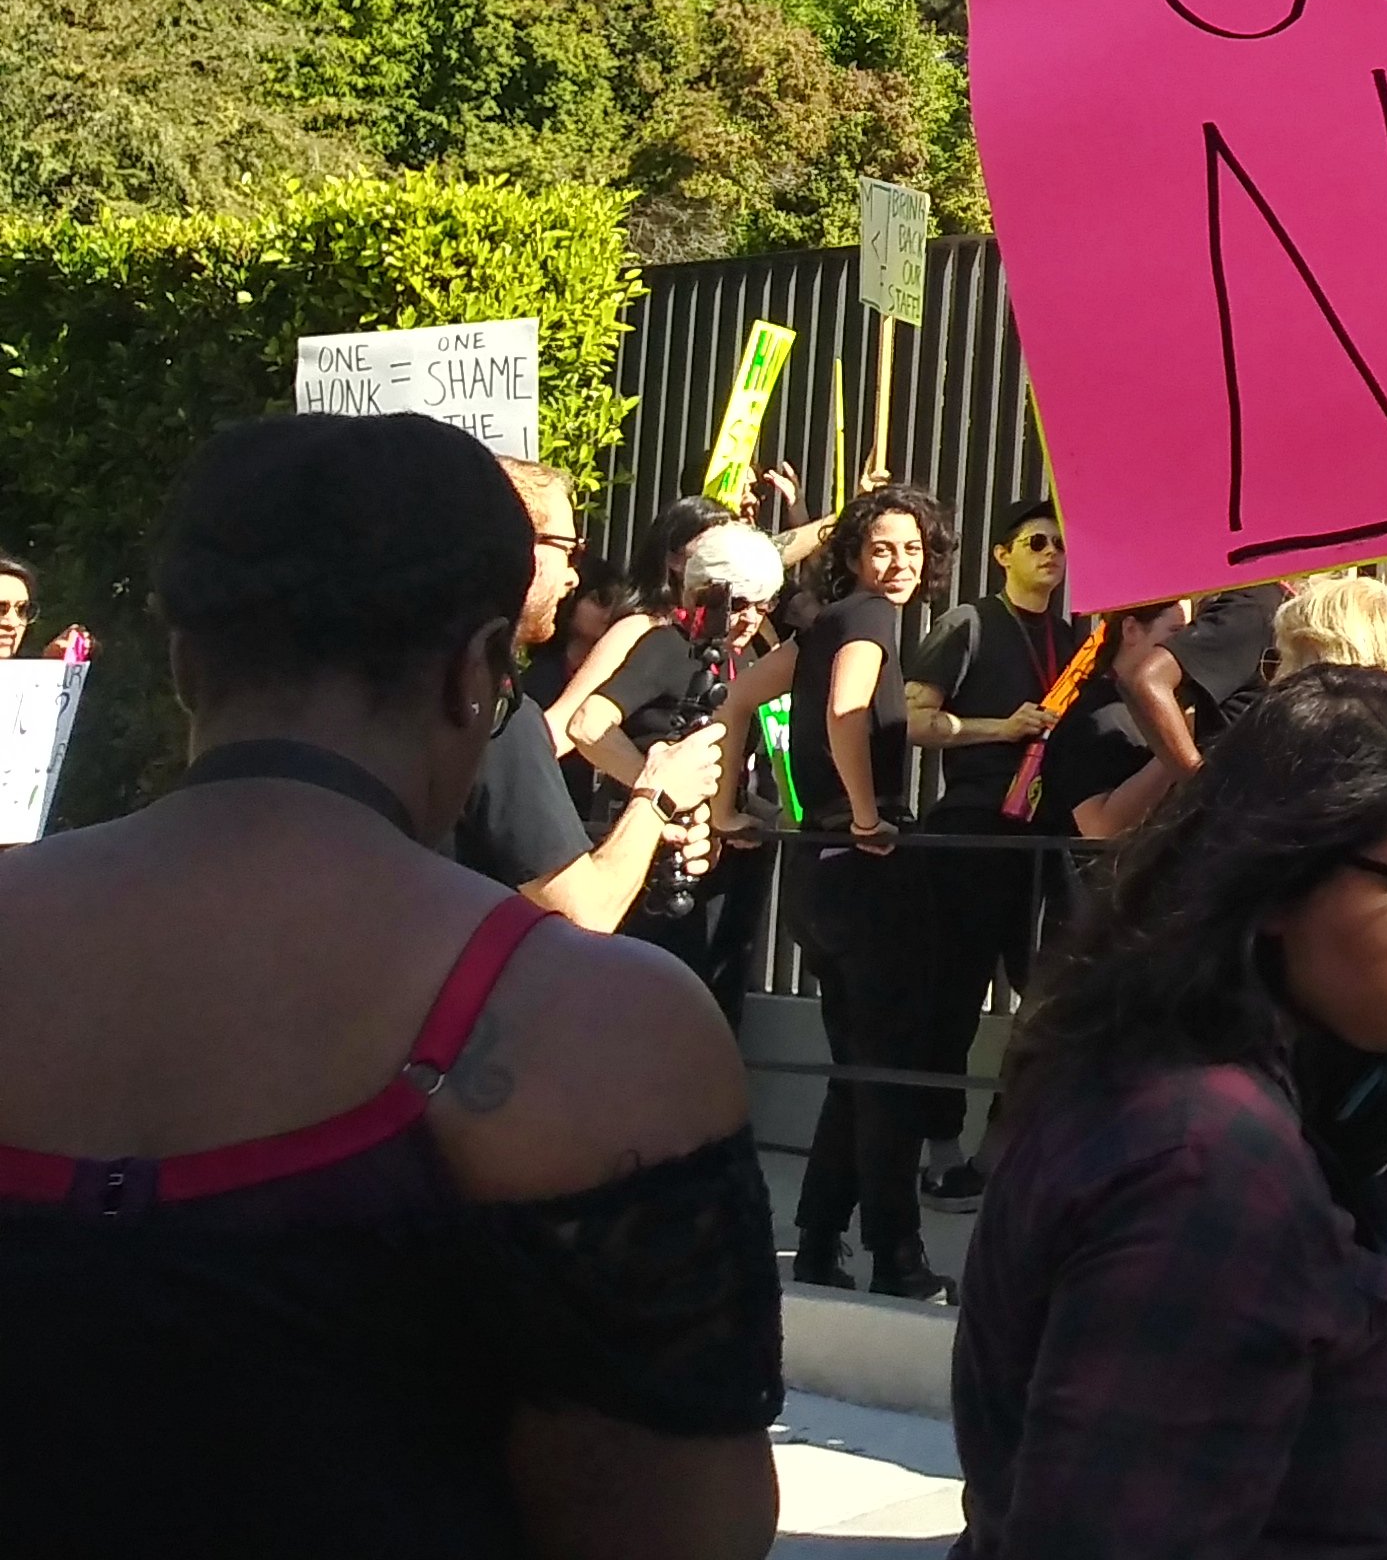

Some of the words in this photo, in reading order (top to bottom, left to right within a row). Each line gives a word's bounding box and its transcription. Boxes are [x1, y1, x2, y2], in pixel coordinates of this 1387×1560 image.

[892, 188, 926, 221] BRING
[898, 223, 927, 258] BACK
[902, 258, 923, 287] OUR
[318, 344, 372, 373] ONE
[437, 332, 487, 352] ONE
[305, 377, 382, 415] HONK
[423, 355, 532, 407] SHAME
